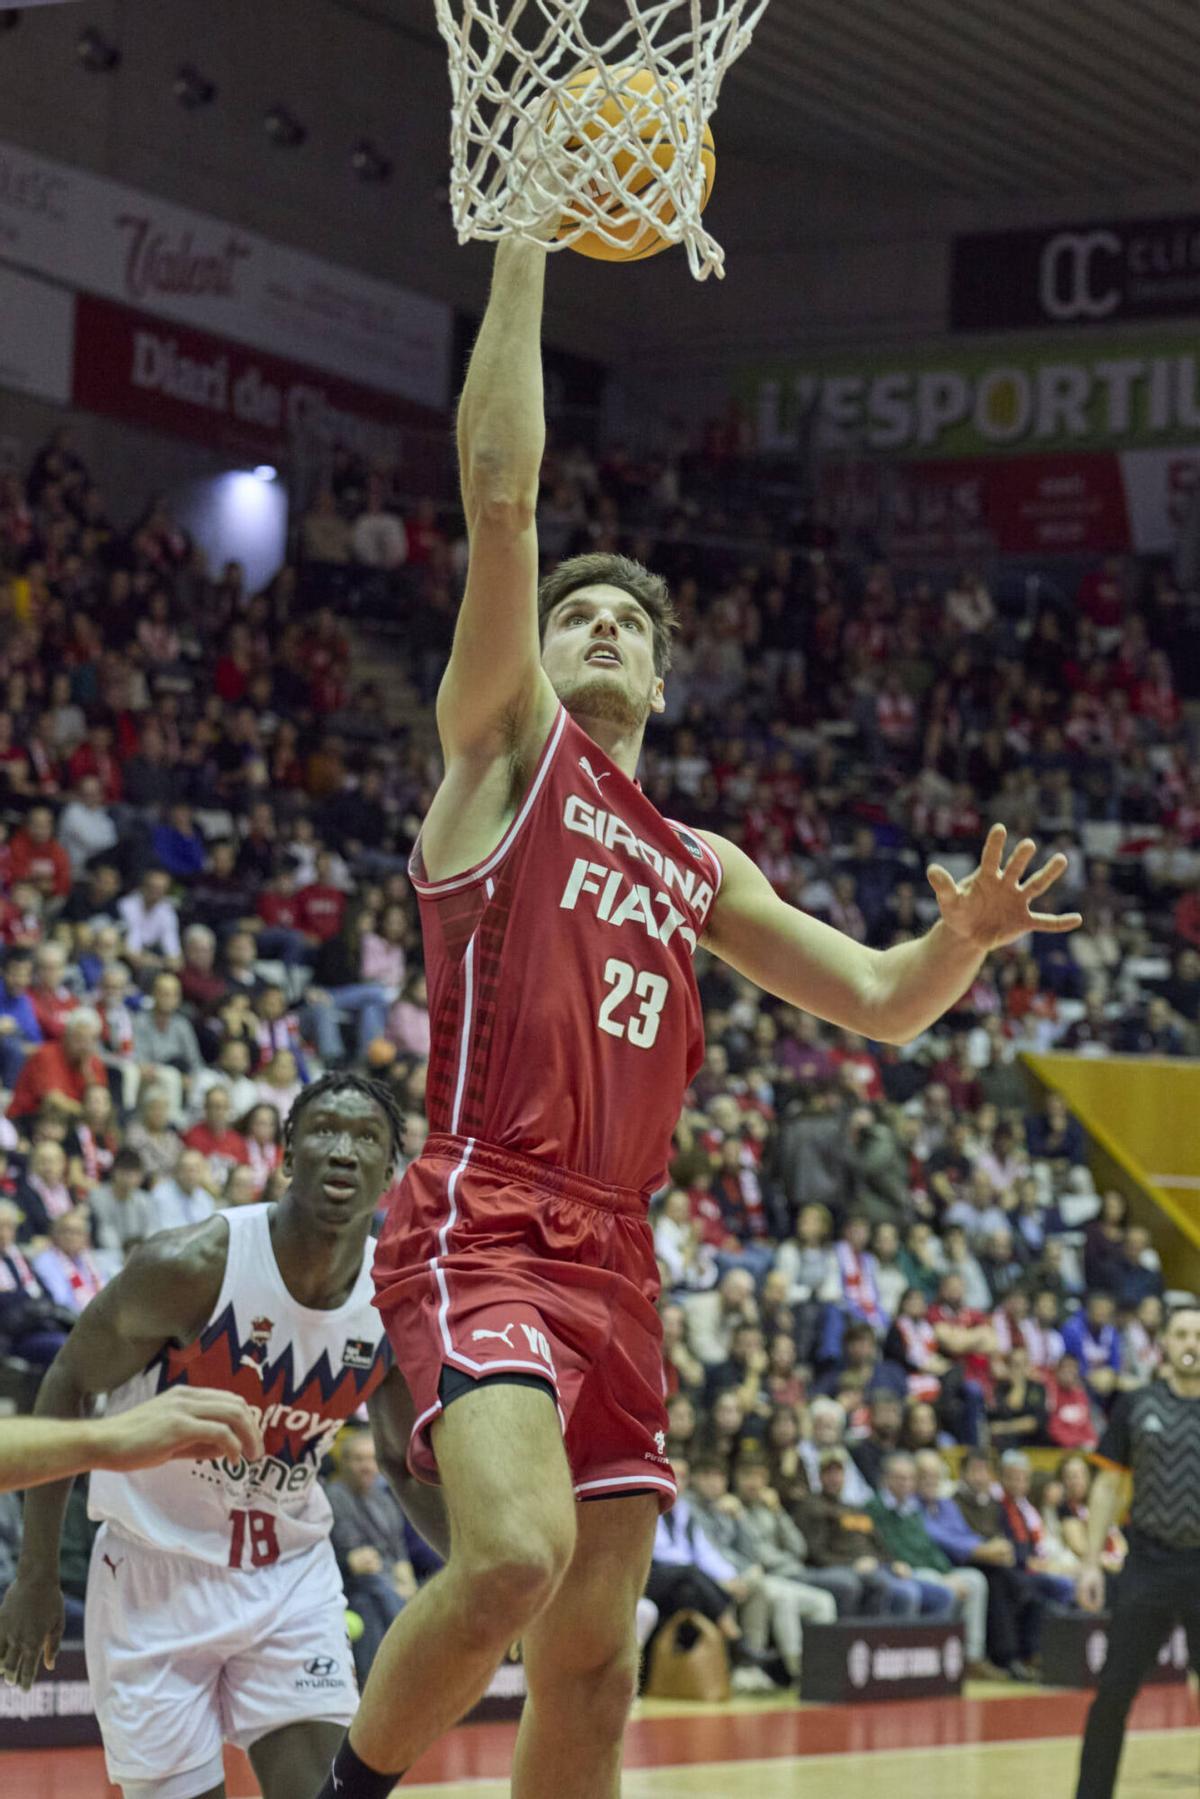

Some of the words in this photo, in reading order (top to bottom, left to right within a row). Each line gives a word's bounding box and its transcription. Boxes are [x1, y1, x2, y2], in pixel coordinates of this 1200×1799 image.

[563, 794, 714, 925] GIRONA
[598, 957, 669, 1049] 23
[229, 1508, 280, 1569] 18
